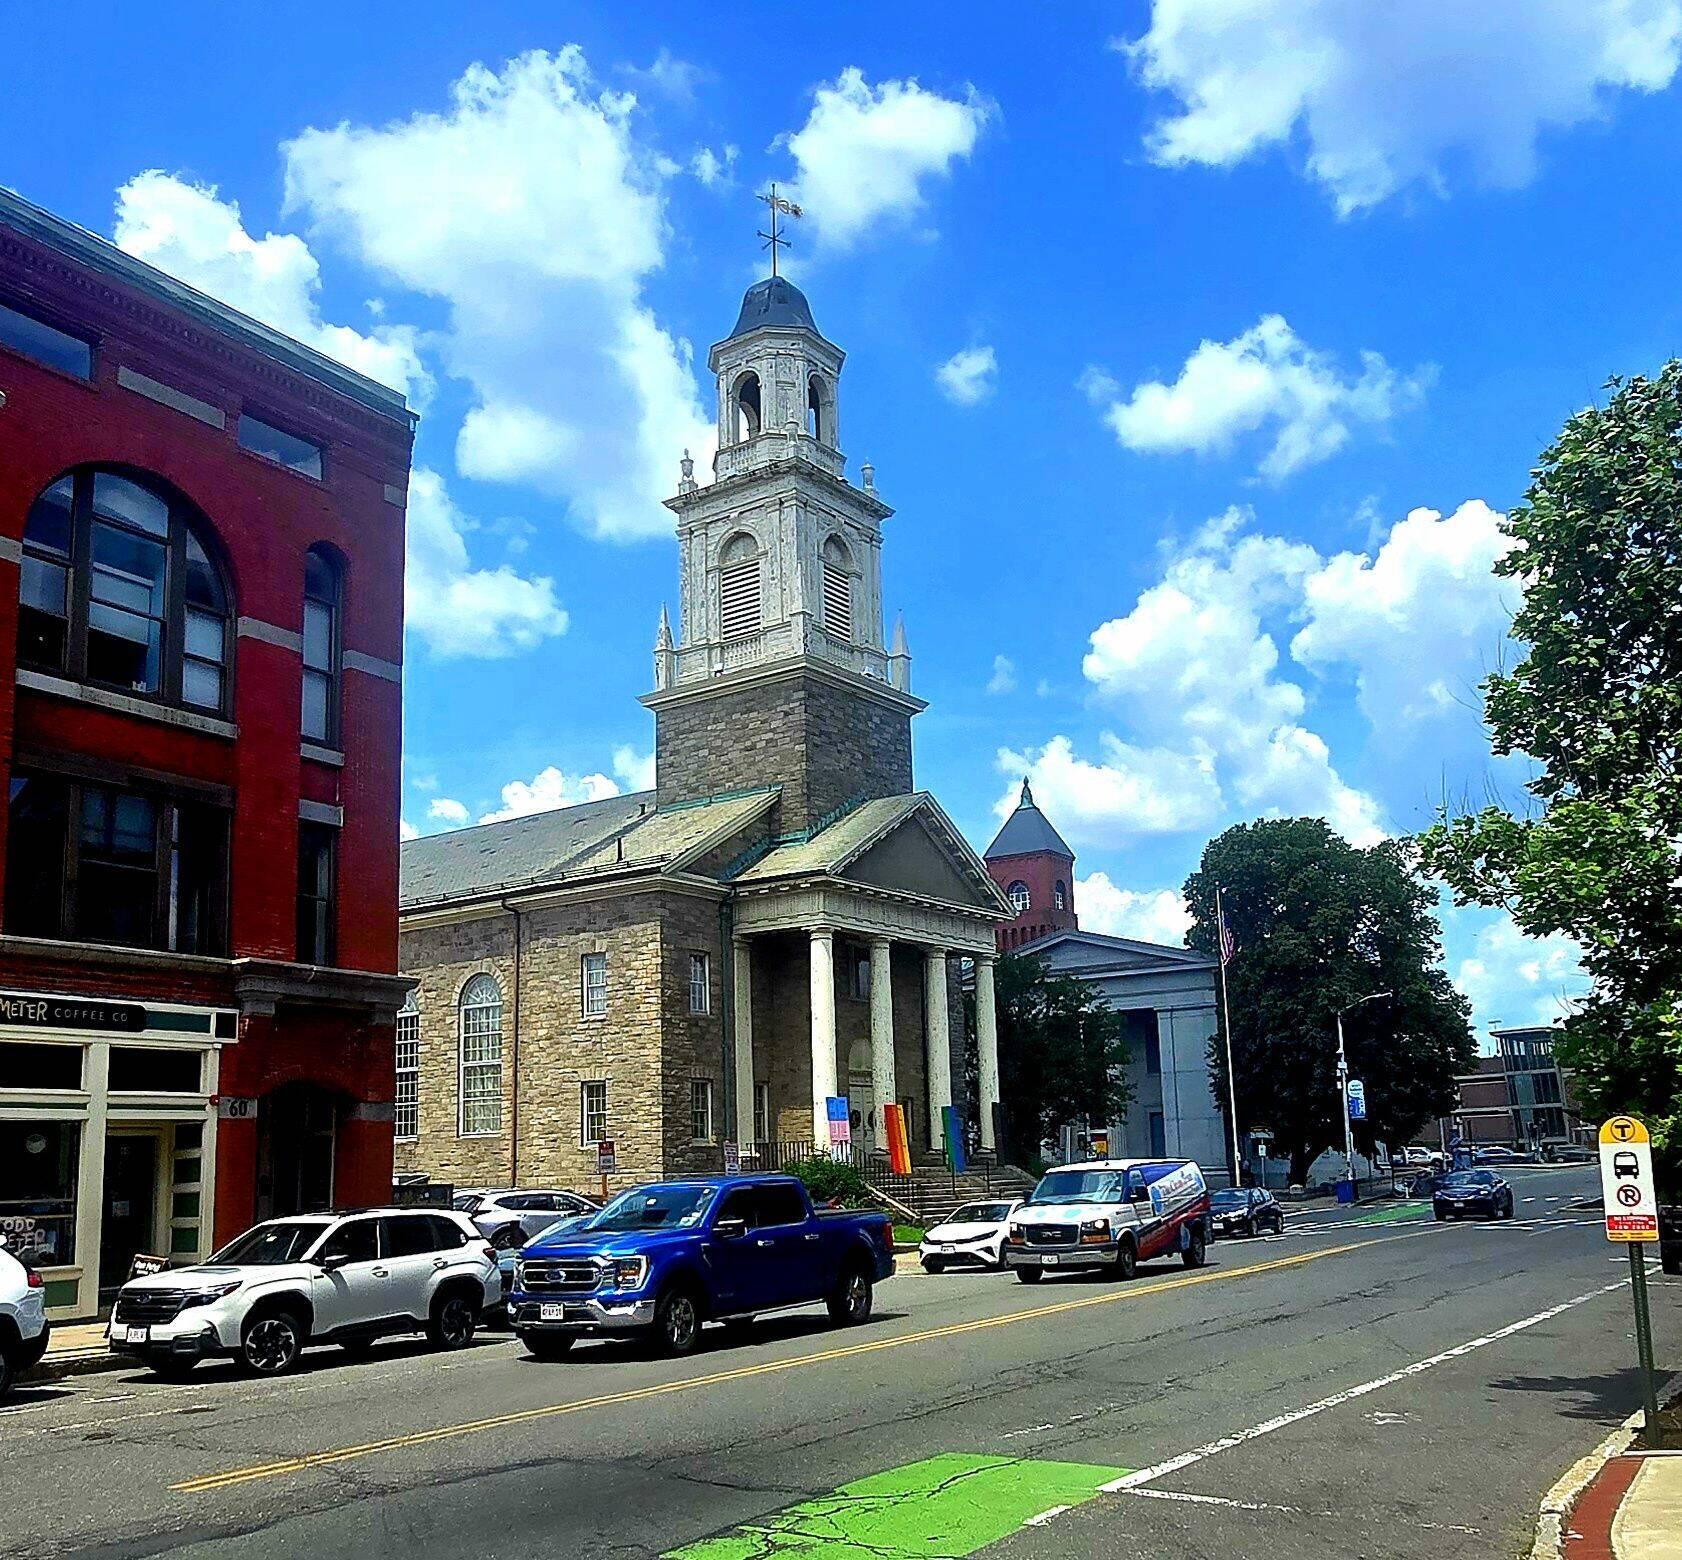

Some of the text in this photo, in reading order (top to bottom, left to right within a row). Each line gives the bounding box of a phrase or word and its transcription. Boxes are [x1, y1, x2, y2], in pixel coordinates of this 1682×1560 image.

[54, 1008, 105, 1021] COFFEE
[112, 1012, 128, 1022] CO
[229, 1100, 249, 1117] 60
[1615, 1124, 1631, 1138] T
[7, 1229, 46, 1252] ETER
